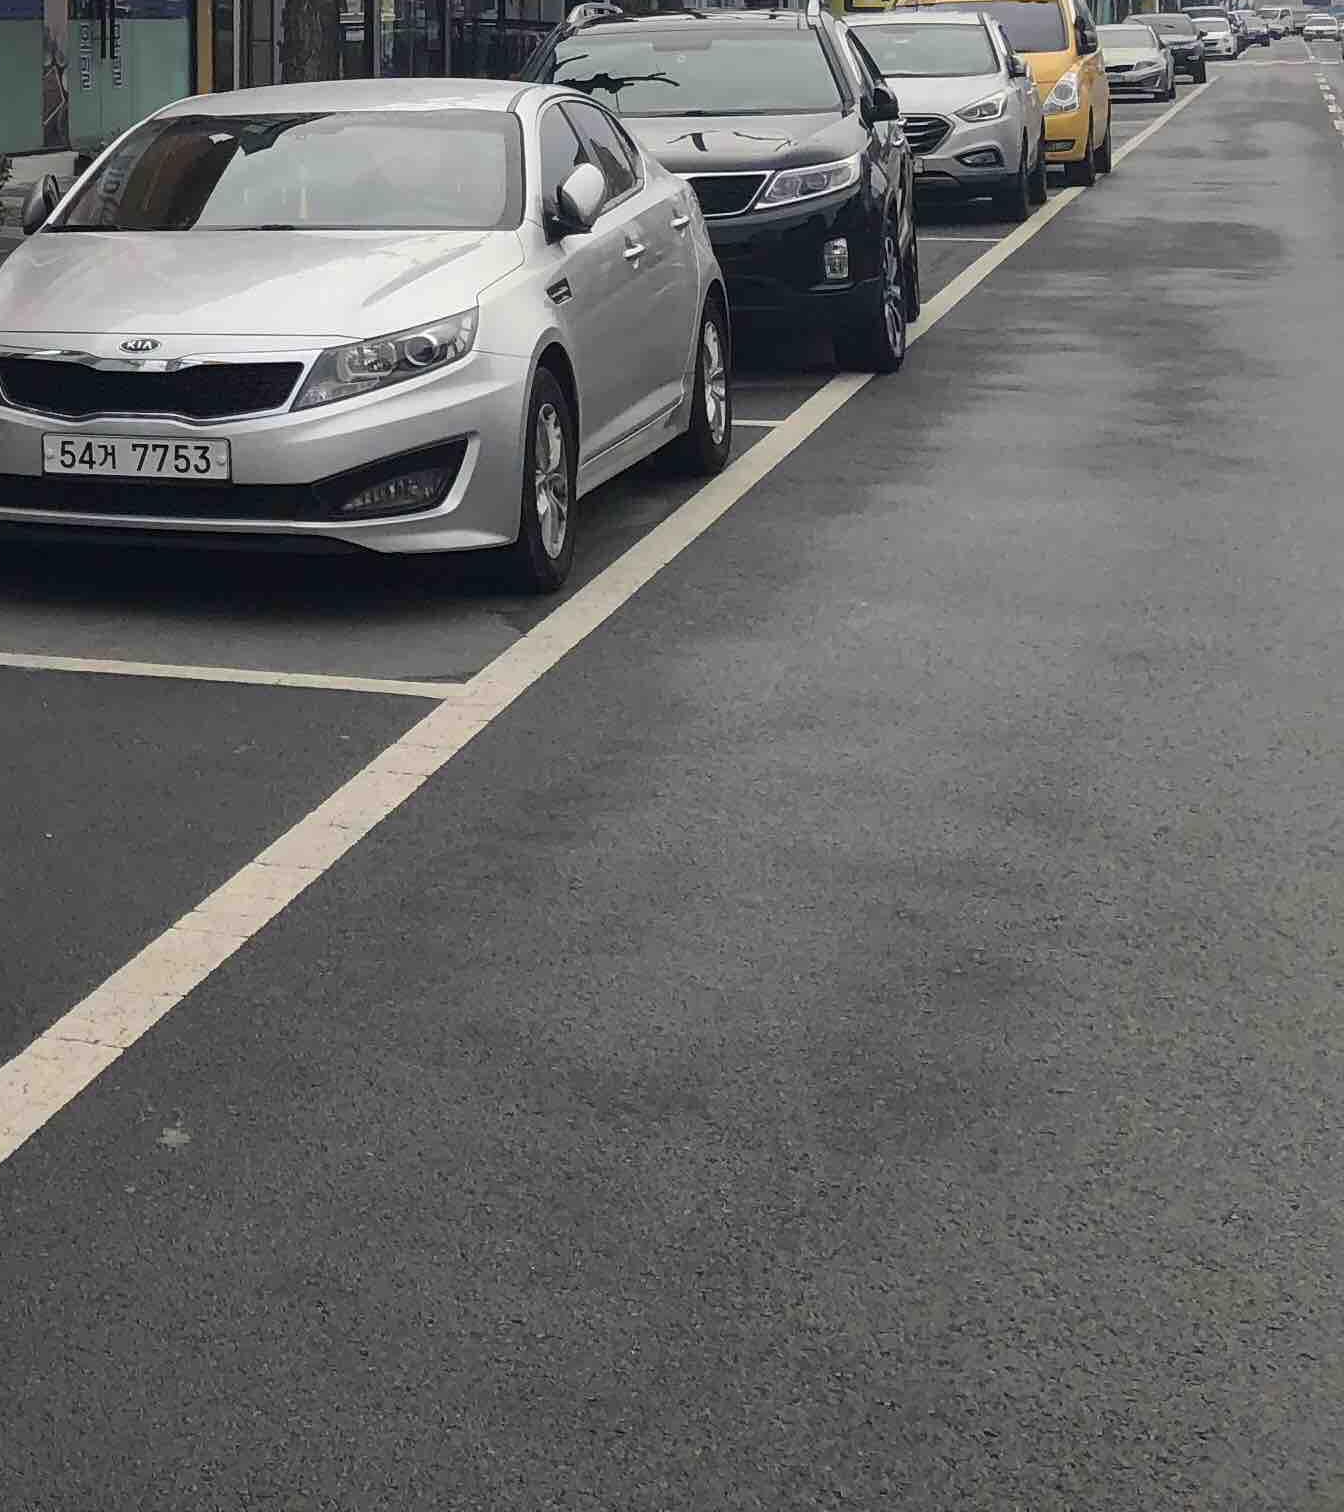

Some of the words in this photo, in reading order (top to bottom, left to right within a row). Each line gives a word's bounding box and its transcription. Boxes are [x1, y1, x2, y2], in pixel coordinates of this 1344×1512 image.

[126, 340, 154, 352] KIA
[60, 440, 116, 471] 54거
[132, 443, 211, 473] 7753
